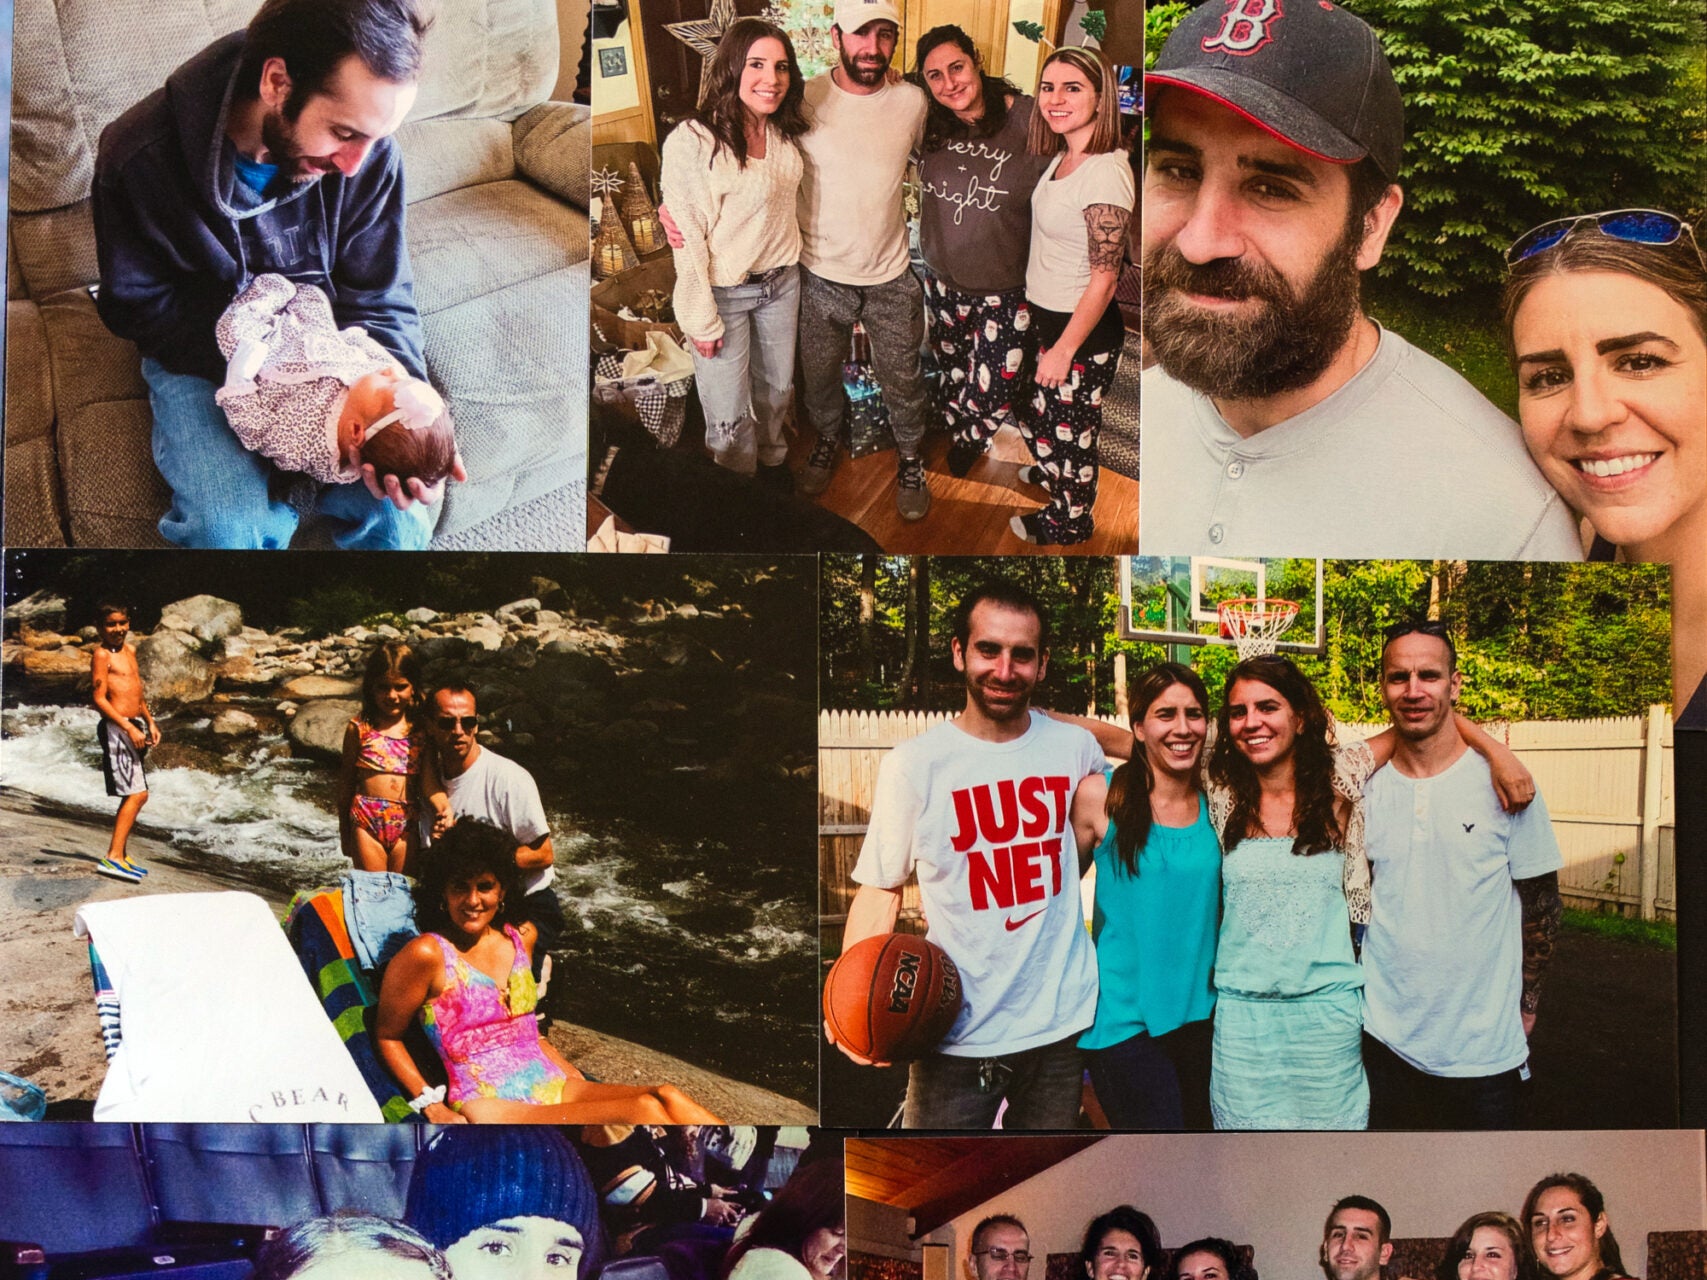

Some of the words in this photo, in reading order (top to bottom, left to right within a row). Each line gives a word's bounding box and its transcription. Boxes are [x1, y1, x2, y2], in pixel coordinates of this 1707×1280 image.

[950, 776, 1071, 853] JUST
[967, 837, 1063, 911] NET
[887, 950, 921, 1014] NCAA
